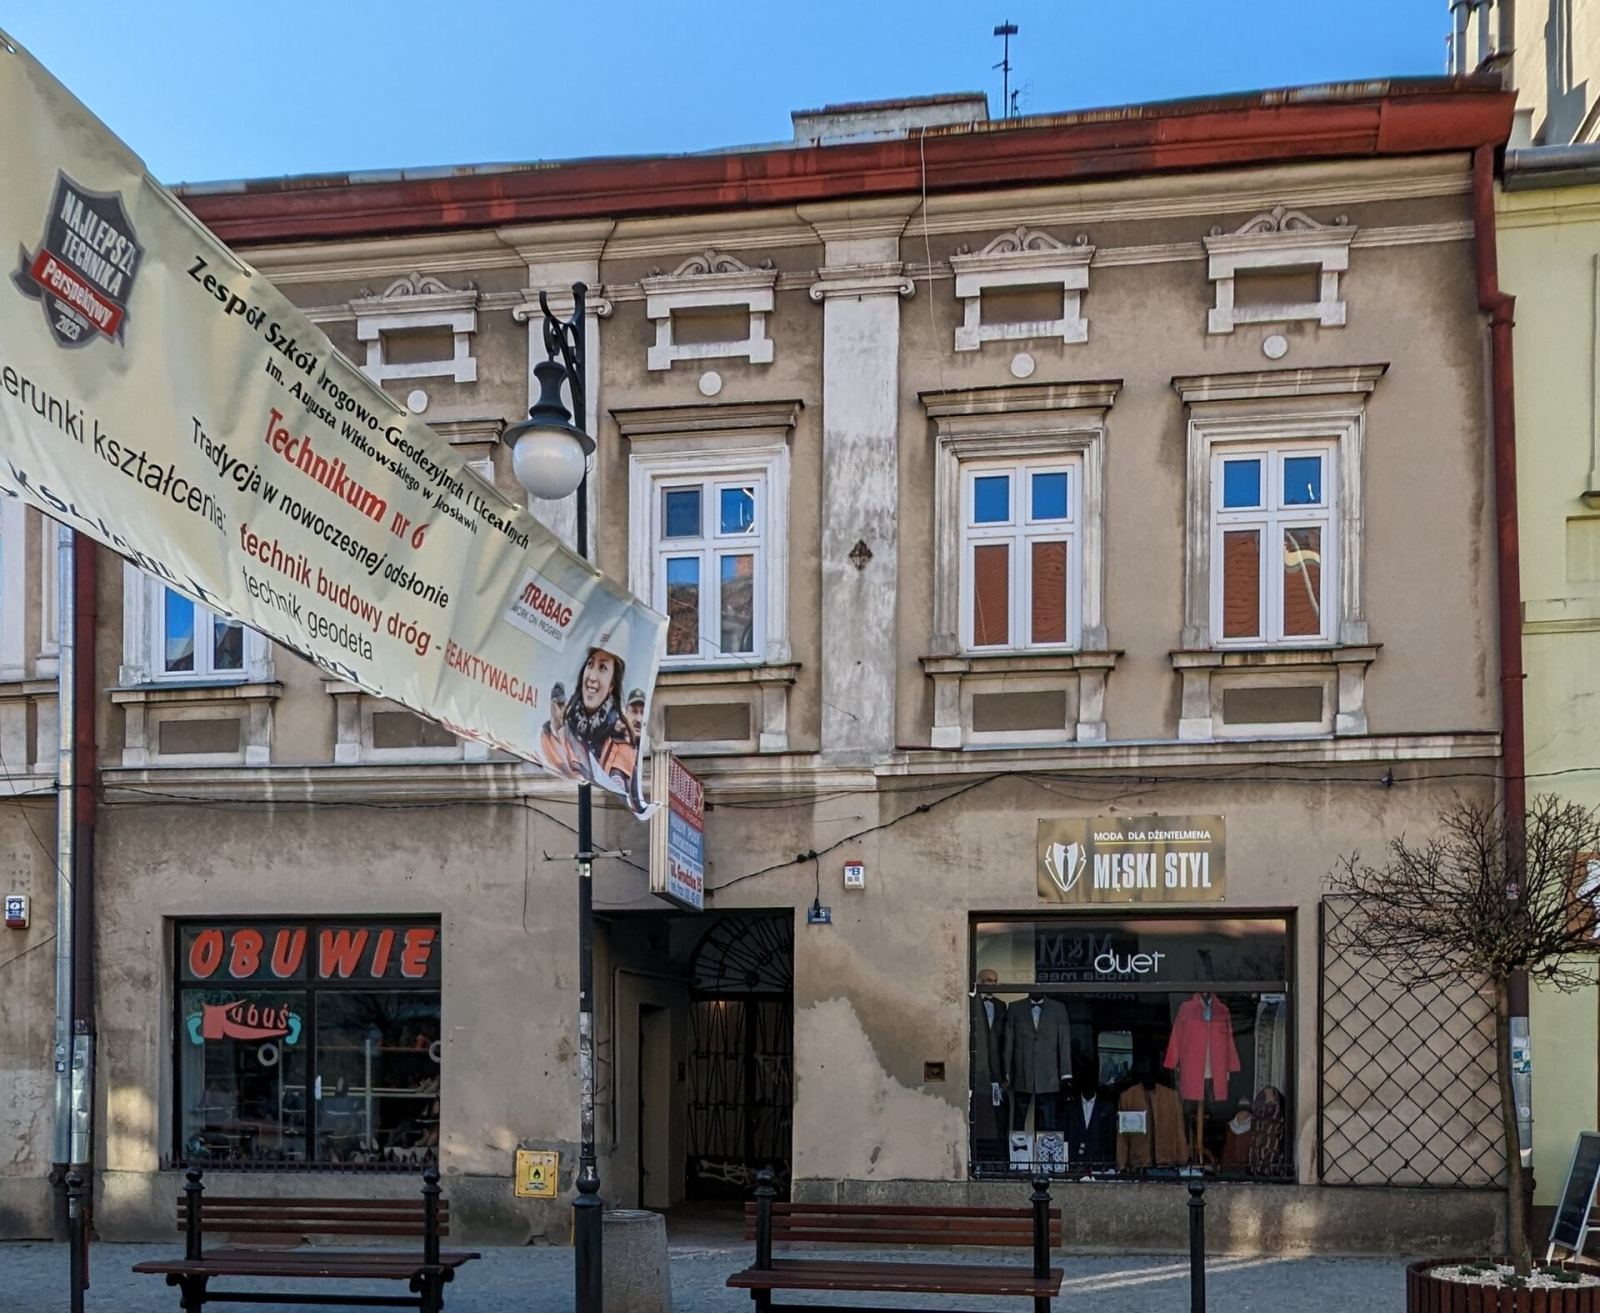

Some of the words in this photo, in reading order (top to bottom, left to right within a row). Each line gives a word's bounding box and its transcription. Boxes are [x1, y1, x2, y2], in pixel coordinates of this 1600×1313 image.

[61, 228, 123, 297] TECHNIKA
[187, 255, 266, 330] Zespół
[264, 322, 318, 376] Szkół
[466, 490, 473, 505] i
[474, 496, 530, 550] Licealnych
[265, 356, 284, 386] im.
[341, 420, 420, 490] Witkowskiego
[422, 487, 434, 500] w
[0, 366, 83, 443] erunki
[94, 420, 227, 536] kształcenia:
[264, 406, 388, 525] Technikum
[390, 511, 411, 539] nr
[411, 523, 431, 550] 6
[192, 416, 262, 493] Tradycja
[263, 482, 279, 504] w
[279, 494, 387, 576] nowoczesnej
[384, 562, 449, 609] odsłonie
[240, 522, 312, 589] technik
[316, 567, 383, 633] budowy
[387, 612, 431, 656] dróg
[444, 637, 539, 708] REAKTYWACJA!
[243, 565, 303, 625] technik
[308, 611, 373, 661] geodeta
[520, 582, 573, 627] STRABAG
[1094, 832, 1124, 841] MODA
[1128, 831, 1145, 841] DLA
[1148, 830, 1211, 841] DŻENTELMENA
[1094, 853, 1157, 892] MĘSKI
[1165, 852, 1212, 888] STYL
[189, 928, 436, 978] OBUWIE
[1094, 949, 1165, 973] duet
